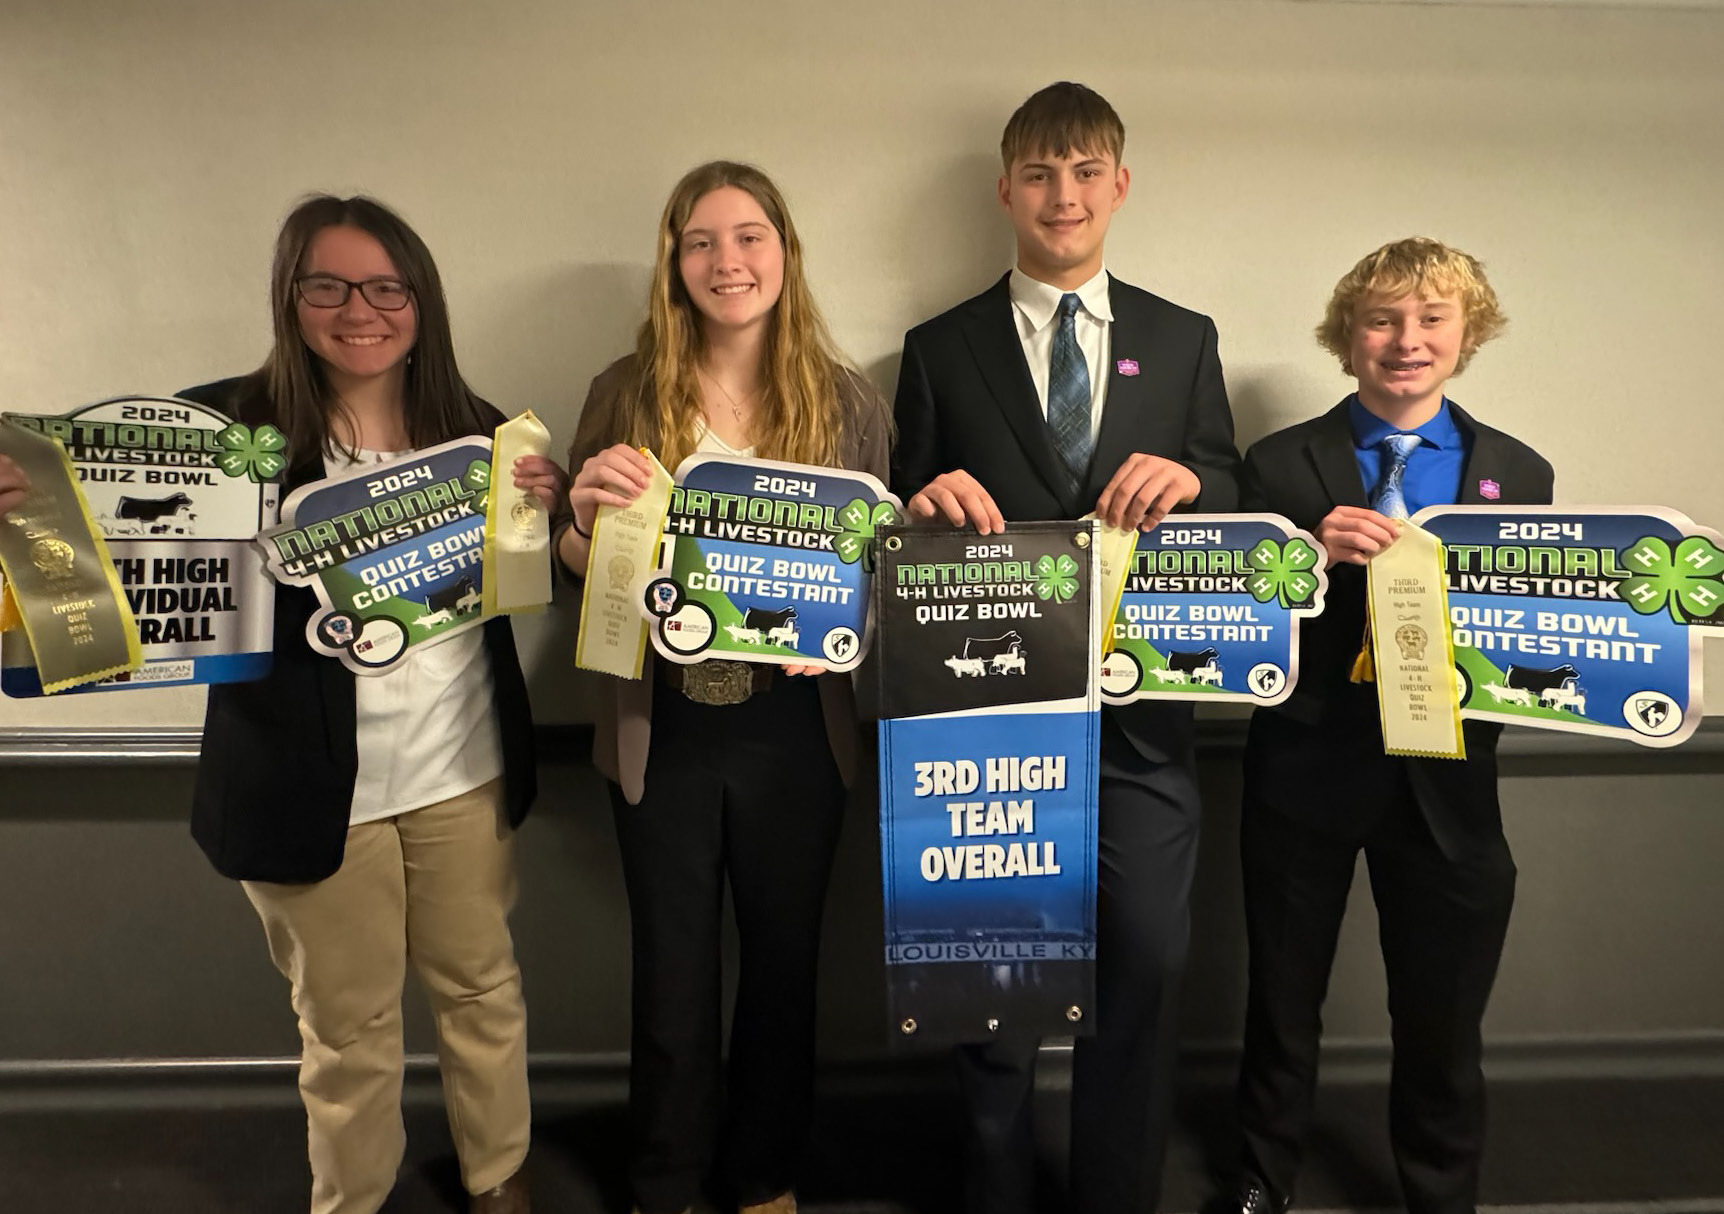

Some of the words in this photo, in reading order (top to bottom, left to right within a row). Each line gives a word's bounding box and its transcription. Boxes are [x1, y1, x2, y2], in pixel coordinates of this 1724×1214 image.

[121, 405, 191, 424] 2024
[68, 445, 217, 467] LIVESTOCK
[145, 471, 219, 487] BOWL
[367, 464, 433, 498] 2024
[754, 475, 816, 498] 2024
[273, 476, 477, 560] NATIONAL
[671, 487, 844, 533] NATIONAL
[615, 515, 647, 530] PREMIUM
[1499, 522, 1583, 541] 2024
[284, 550, 335, 577] 4-H
[342, 501, 476, 559] LIVESTOCK
[704, 520, 834, 551] LIVESTOCK
[1161, 529, 1222, 545] 2024
[965, 544, 1013, 559] 2024
[153, 557, 229, 585] HIGH
[360, 550, 423, 587] QUIZ
[706, 552, 764, 576] QUIZ
[773, 559, 842, 583] BOWL
[896, 561, 1040, 586] NATIONAL
[687, 572, 854, 605] CONTESTANT
[896, 587, 927, 600] 4-H
[933, 583, 1034, 599] LIVESTOCK
[1388, 586, 1426, 594] PREMIUM
[1393, 578, 1419, 586] THIRD
[1445, 573, 1622, 600] LIVESTOCK
[915, 604, 970, 625] QUIZ
[977, 602, 1042, 620] BOWL
[1125, 605, 1181, 624] QUIZ
[1189, 605, 1259, 622] BOWL
[1450, 606, 1525, 629] QUIZ
[1537, 611, 1639, 638] BOWL
[1113, 624, 1273, 642] CONTESTANT
[1400, 684, 1433, 692] LIVESTOCK
[1410, 693, 1425, 702] QUIZ
[1409, 703, 1428, 712] BOWL
[1411, 713, 1428, 721] 2024
[914, 760, 979, 797] 3RD
[986, 756, 1066, 793] HIGH
[946, 799, 1034, 837] TEAM
[920, 841, 1061, 882] OVERALL
[888, 943, 1046, 962] LOUISVILLE
[1062, 943, 1095, 960] KY
